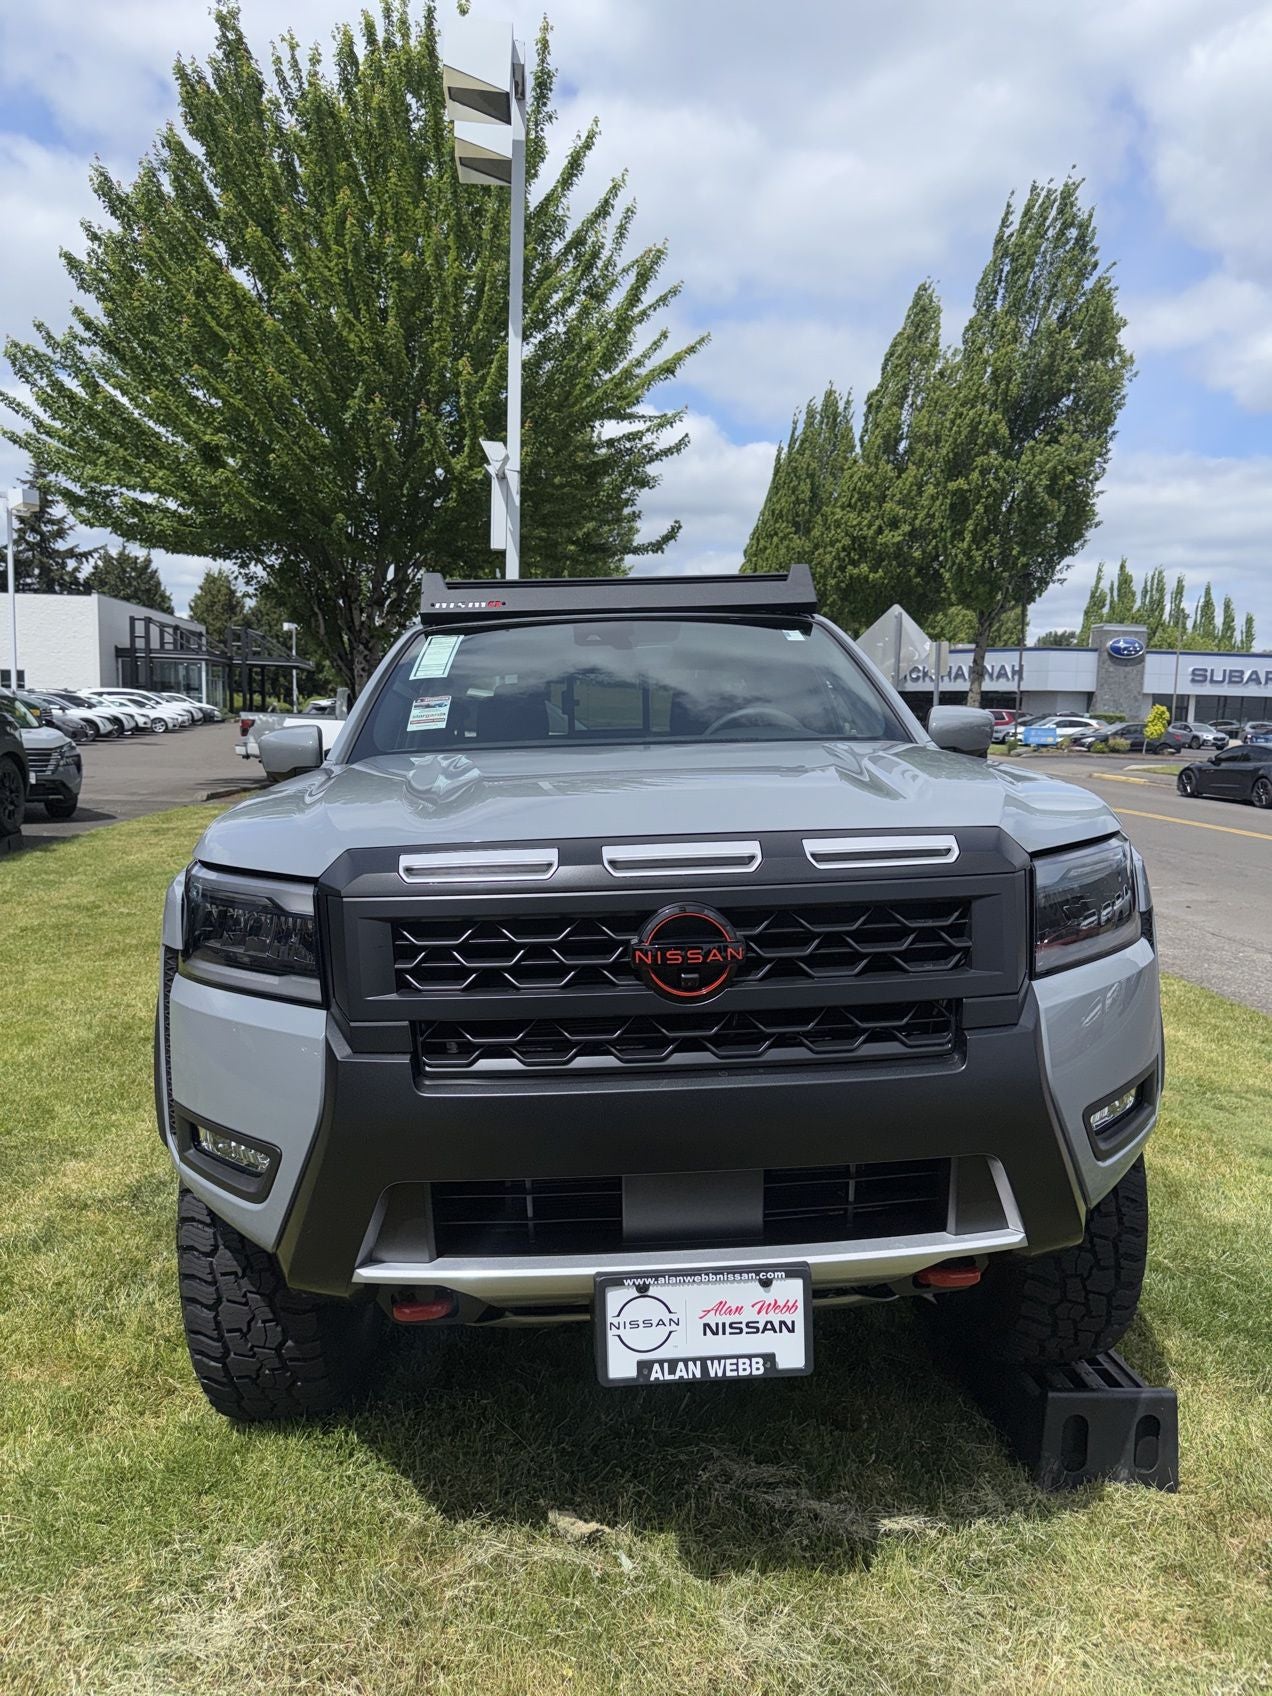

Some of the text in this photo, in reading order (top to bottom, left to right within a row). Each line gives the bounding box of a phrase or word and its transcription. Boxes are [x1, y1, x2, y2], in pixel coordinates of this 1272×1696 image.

[635, 946, 743, 965] NISSAN
[623, 1271, 785, 1286] www.alanwebbnissan.com
[699, 1299, 798, 1319] Alan Webb
[609, 1317, 680, 1331] NISSAN
[702, 1320, 795, 1336] NISSAN
[650, 1357, 765, 1381] ALAN WEBB
